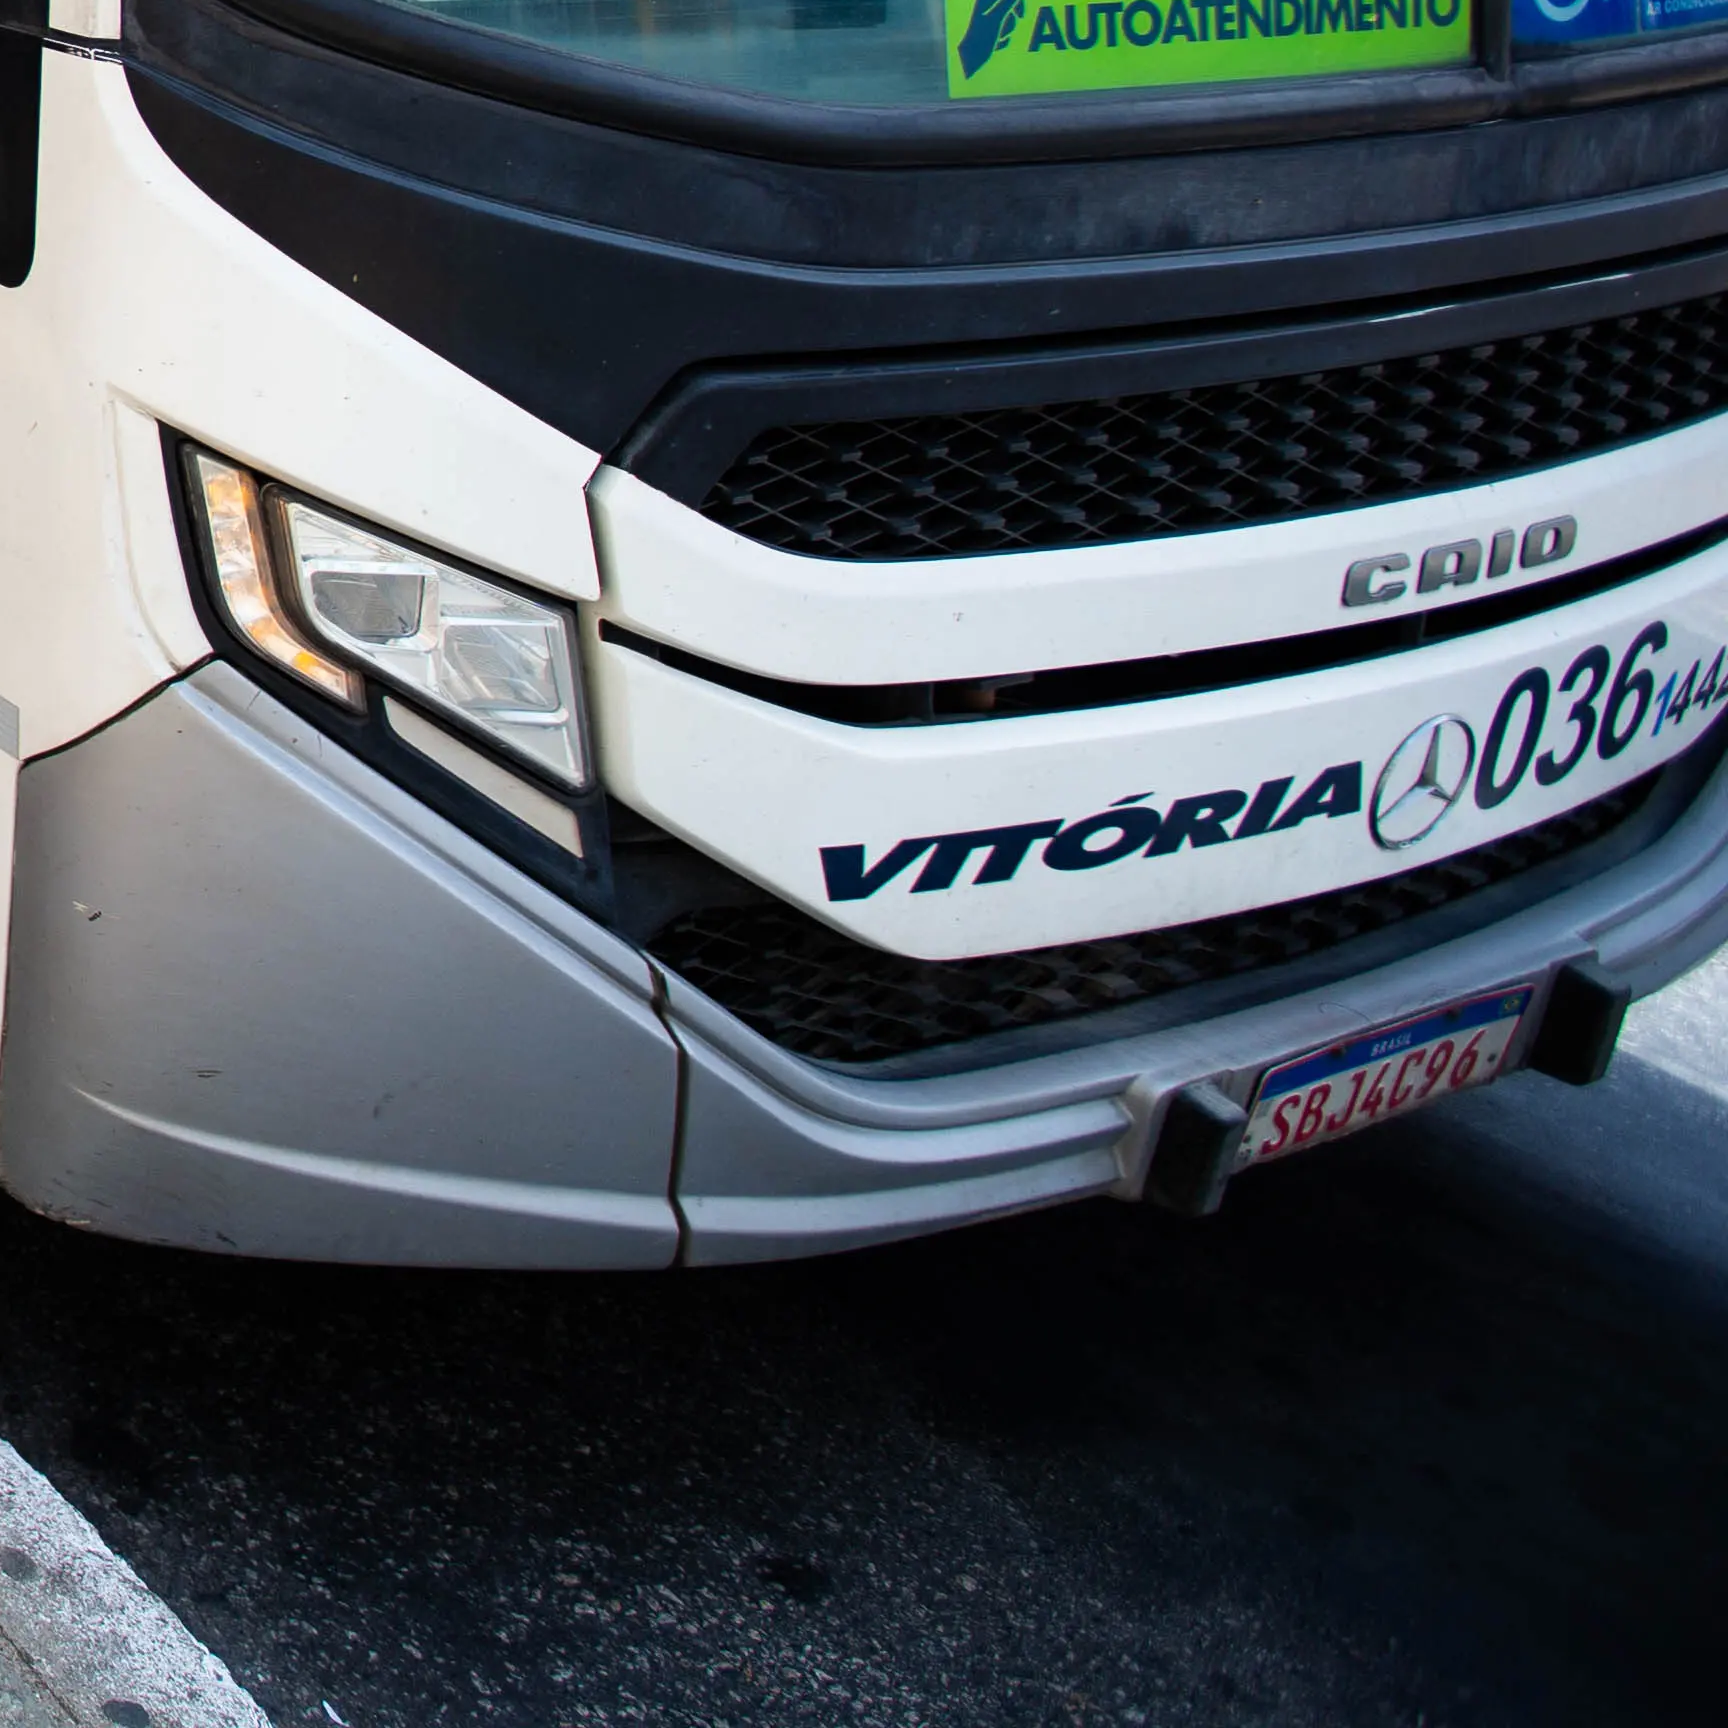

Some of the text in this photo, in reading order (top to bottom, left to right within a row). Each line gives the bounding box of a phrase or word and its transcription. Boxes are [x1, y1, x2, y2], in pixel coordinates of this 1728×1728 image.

[1340, 514, 1578, 608] CAIO
[819, 760, 1363, 902] VITÓRIA
[1261, 1028, 1487, 1155] SBJ4C96
[1370, 1033, 1413, 1057] BRASIL
